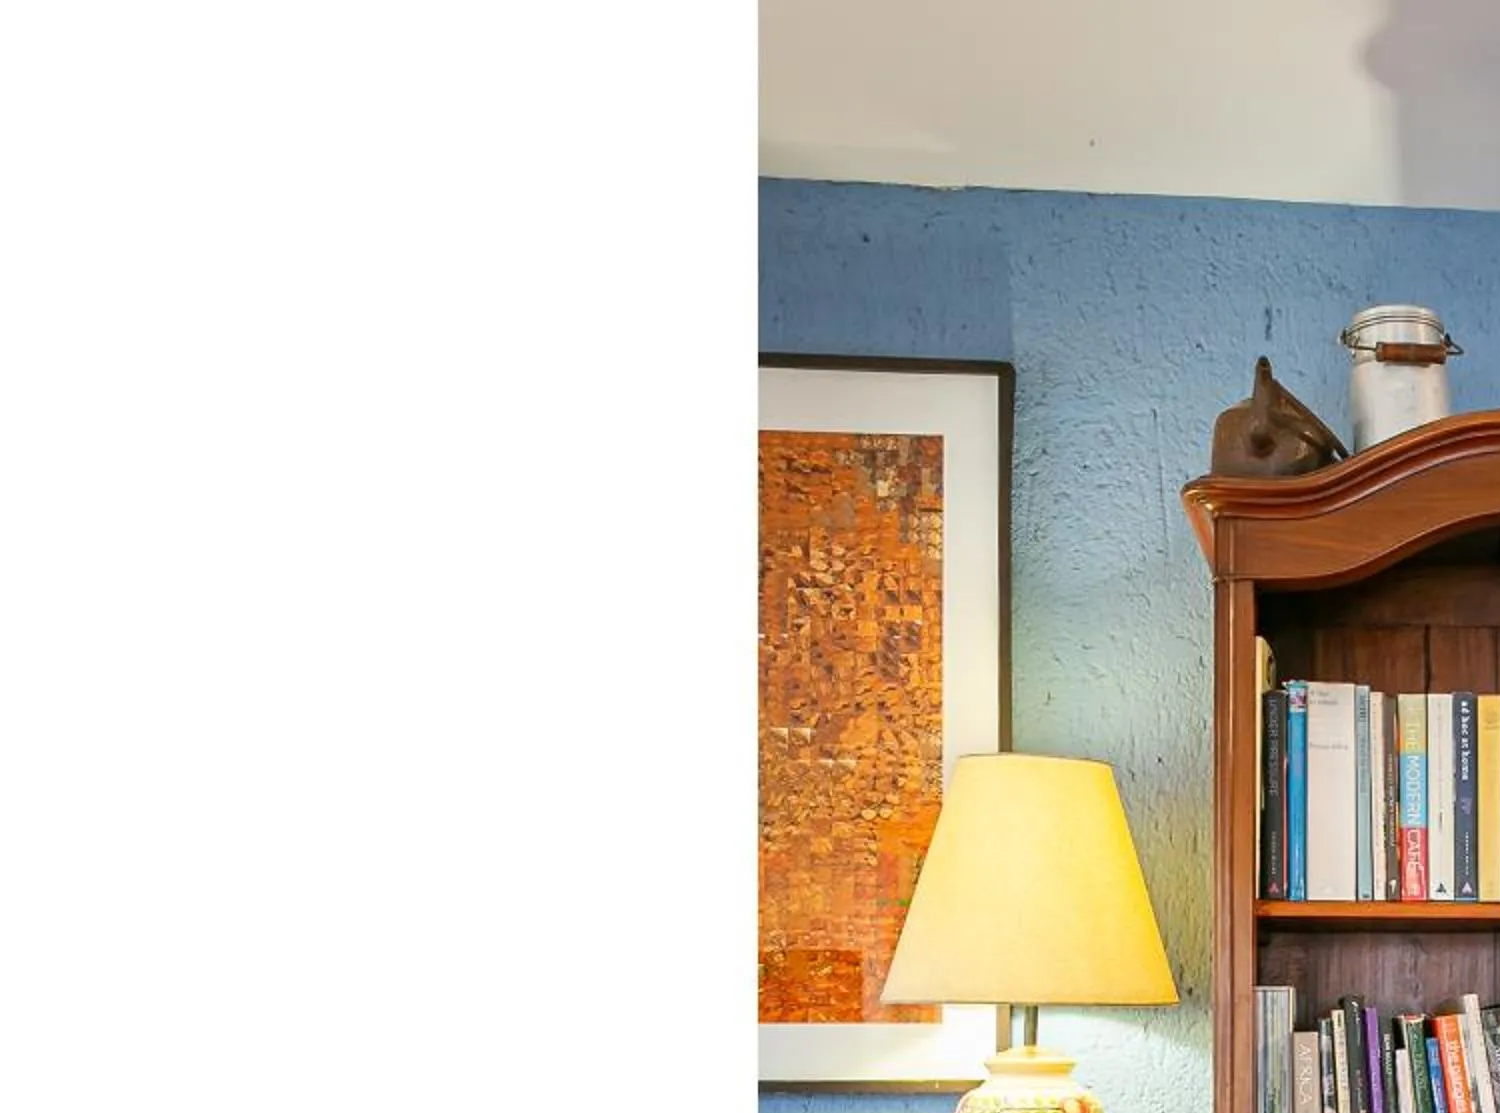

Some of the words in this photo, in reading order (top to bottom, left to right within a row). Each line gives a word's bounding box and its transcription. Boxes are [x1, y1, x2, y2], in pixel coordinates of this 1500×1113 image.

[1407, 754, 1420, 824] MODERN
[1460, 750, 1469, 780] home
[1297, 1043, 1313, 1105] AFRICA
